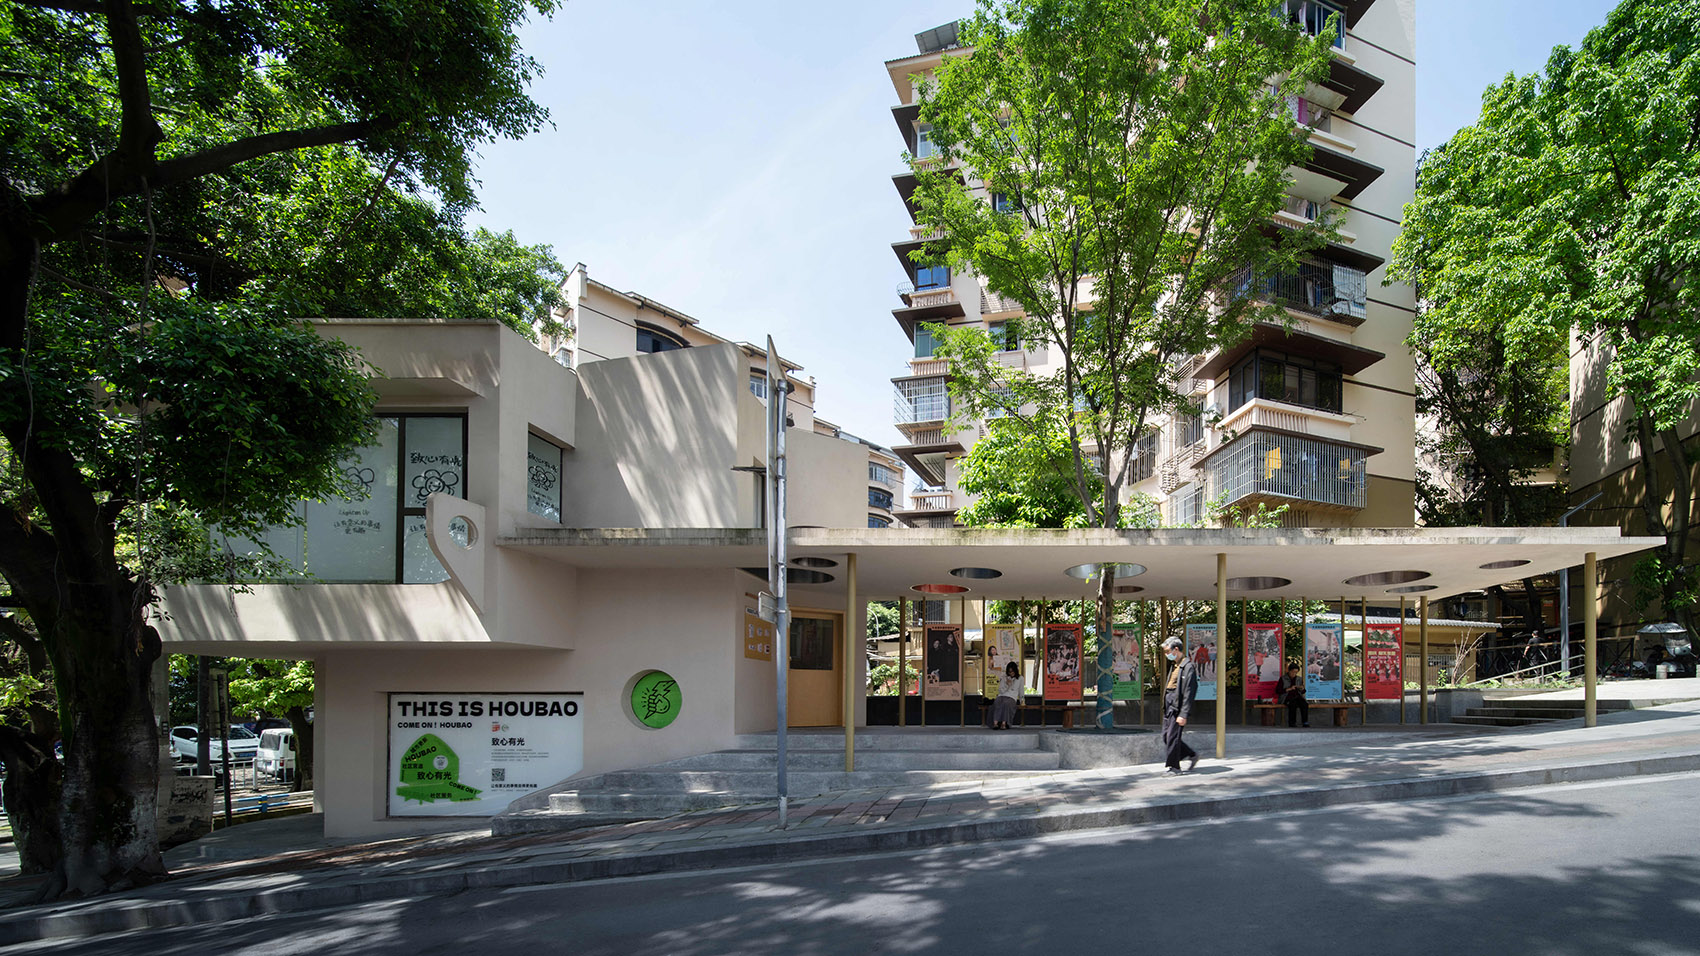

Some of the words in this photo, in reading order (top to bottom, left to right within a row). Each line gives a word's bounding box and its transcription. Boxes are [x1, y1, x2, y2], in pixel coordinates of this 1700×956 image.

[397, 701, 453, 717] THIS
[458, 701, 484, 717] IS
[489, 701, 579, 717] HOUBAO
[397, 721, 420, 729] COME
[439, 721, 473, 729] HOUBAO
[491, 737, 526, 747] 致心有光
[405, 746, 437, 762] HOUBAO
[417, 771, 452, 781] 致心有光
[449, 781, 464, 791] COME
